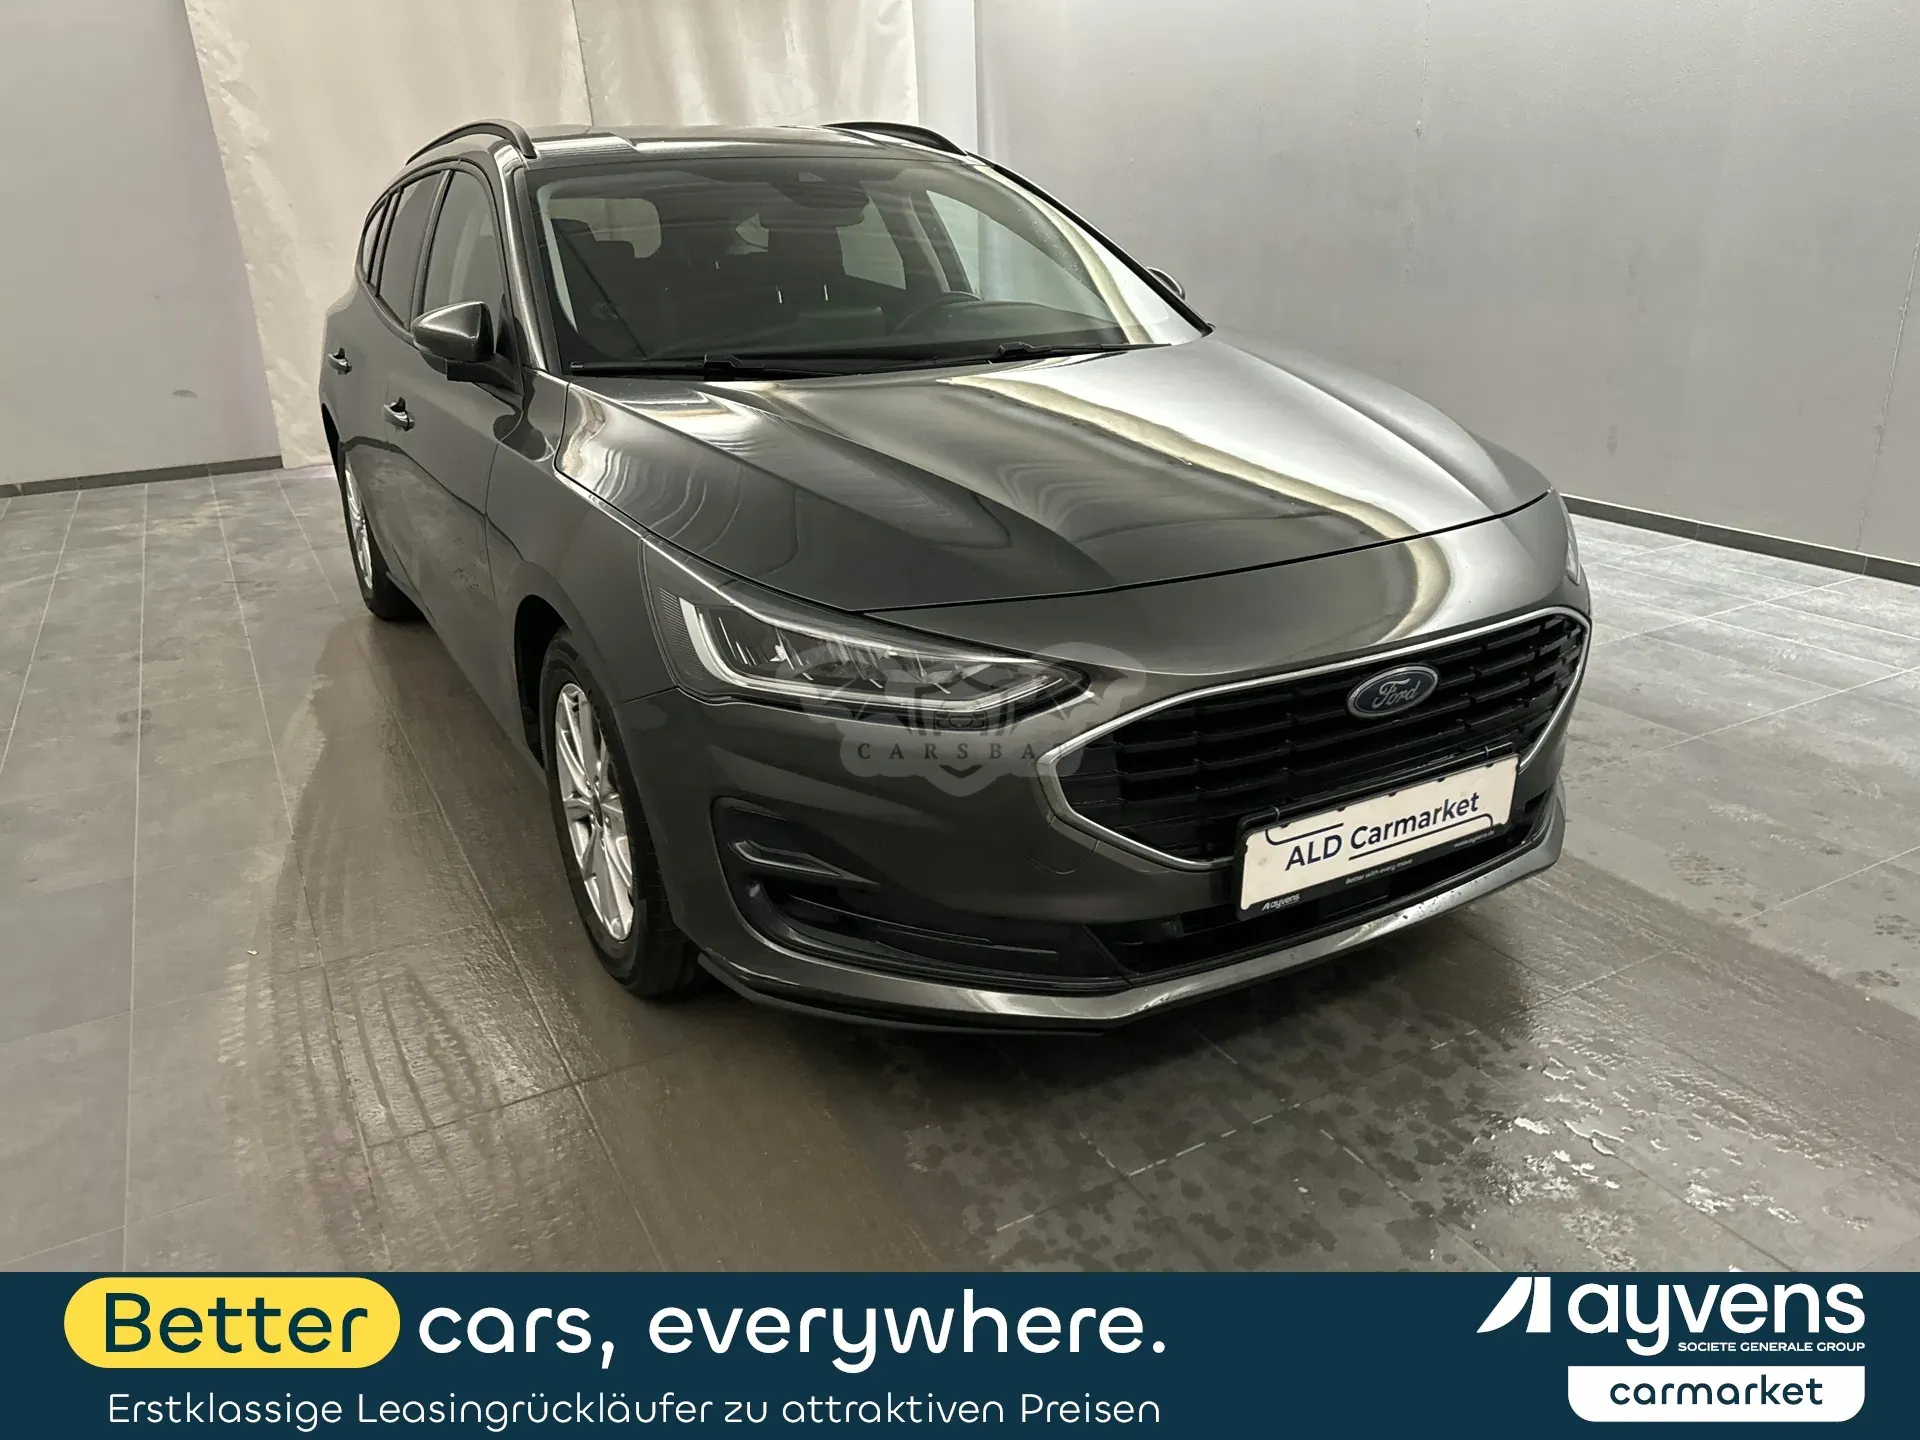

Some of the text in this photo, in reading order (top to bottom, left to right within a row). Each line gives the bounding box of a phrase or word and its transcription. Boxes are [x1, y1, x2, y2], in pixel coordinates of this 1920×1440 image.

[1371, 677, 1421, 709] Ford
[1284, 792, 1480, 871] ALD Carmarket
[1345, 874, 1365, 885] Better
[1365, 869, 1379, 879] with
[1379, 863, 1396, 873] every
